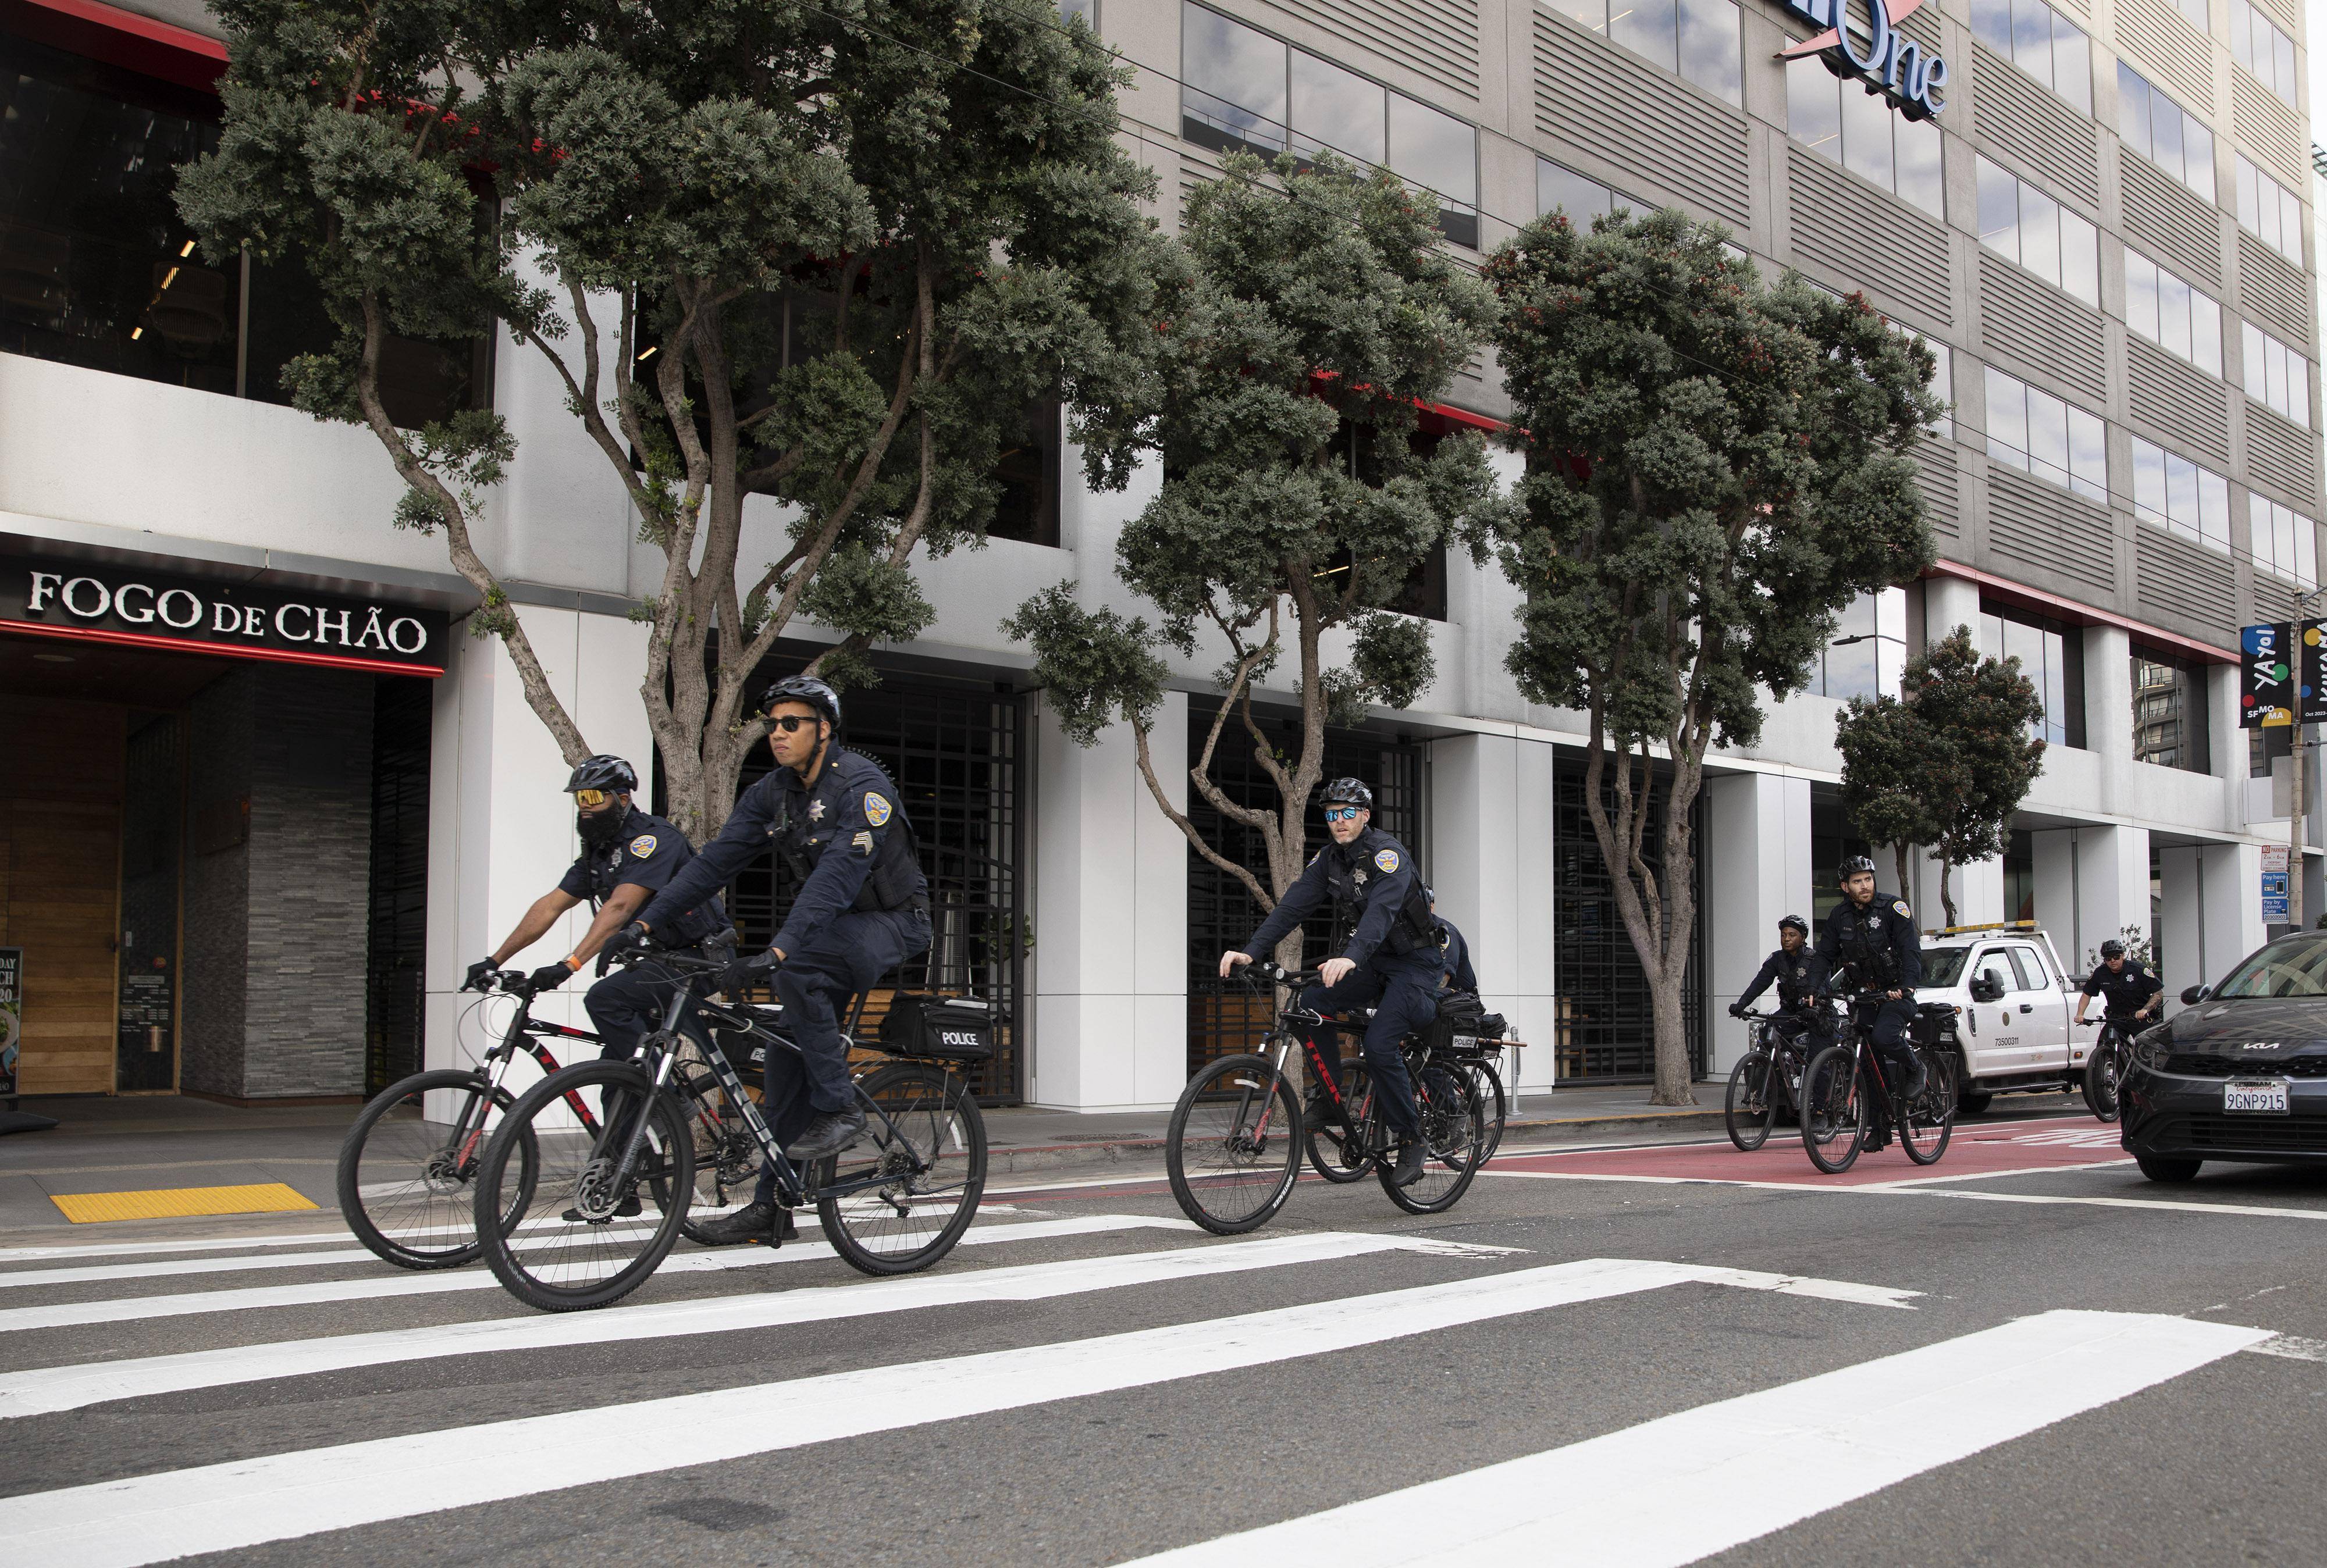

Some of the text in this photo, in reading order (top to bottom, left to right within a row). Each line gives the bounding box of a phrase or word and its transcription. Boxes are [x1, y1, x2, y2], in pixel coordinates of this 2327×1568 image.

[28, 571, 428, 654] FOGO DE CHÃO
[2254, 629, 2279, 690] YAYOI
[942, 1032, 979, 1045] POLICE
[1995, 1036, 2019, 1046] 73500311
[1305, 1035, 1342, 1105] TREK
[709, 1040, 784, 1161] TREK
[2228, 1093, 2284, 1109] 9GNP915
[1272, 1174, 1293, 1209] BONTRAGER
